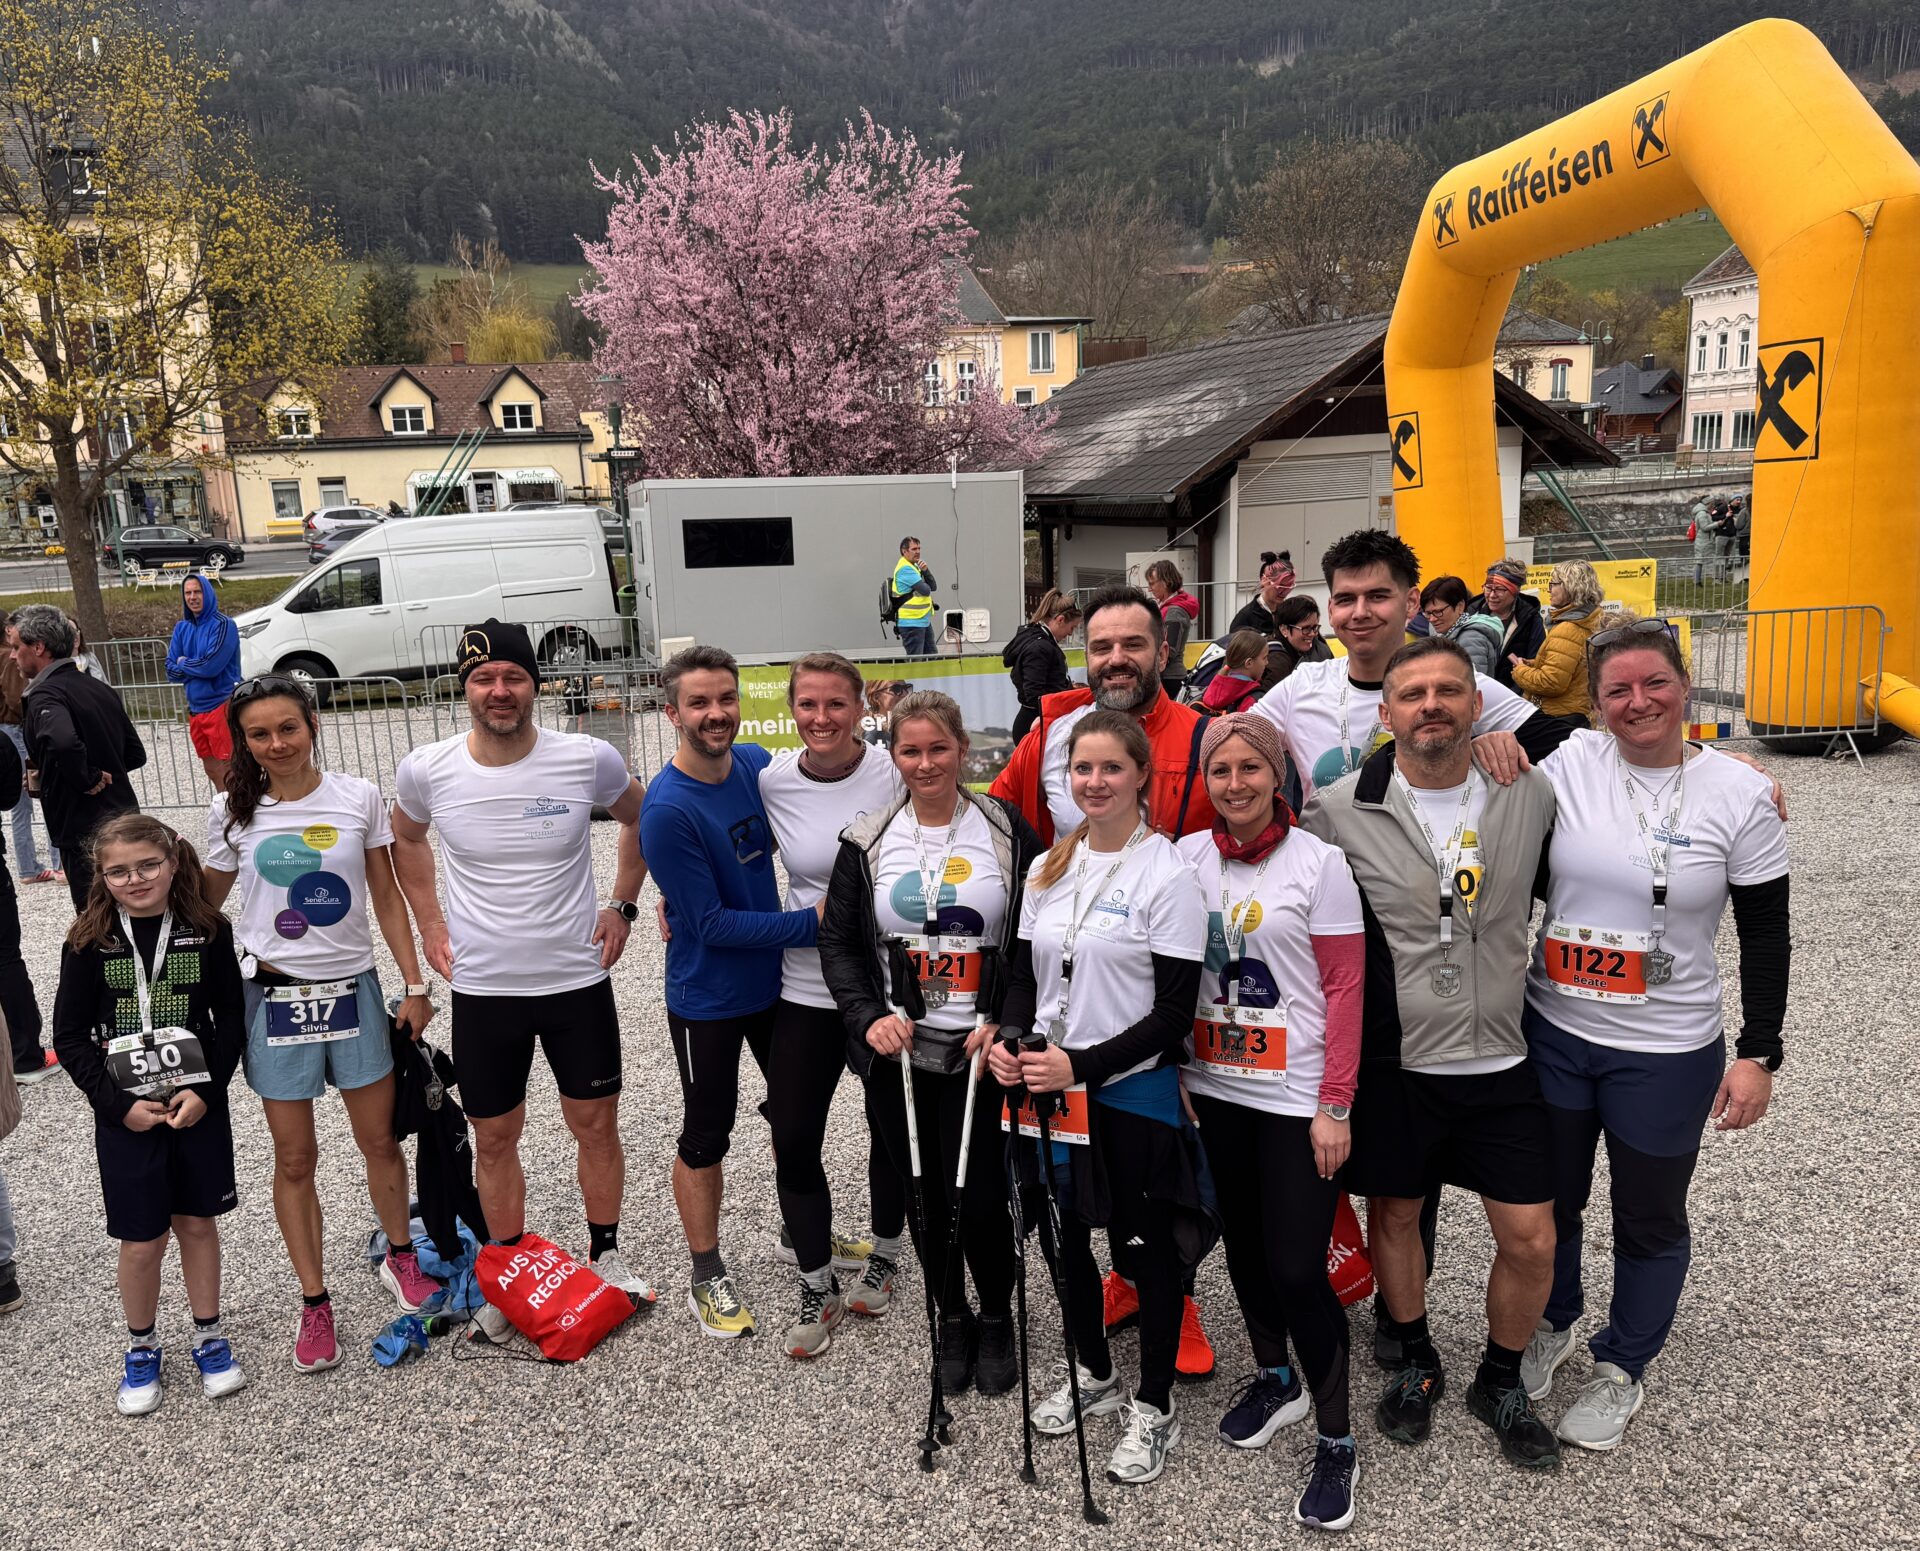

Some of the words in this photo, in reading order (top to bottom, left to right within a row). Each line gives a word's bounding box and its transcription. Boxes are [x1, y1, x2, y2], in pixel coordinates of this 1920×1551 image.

[1467, 139, 1614, 230] Raiffeisen
[516, 470, 545, 479] Gruber
[748, 681, 789, 690] BUCKLIG
[748, 690, 774, 699] WELT
[524, 804, 568, 813] SeneCura
[1560, 944, 1626, 979] 1122
[1573, 974, 1607, 988] Beate
[290, 999, 337, 1024] 317
[300, 1023, 330, 1034] Silvia
[129, 1043, 182, 1076] 50
[1213, 1051, 1258, 1066] Melanie
[138, 1068, 185, 1084] Vanessa
[497, 1253, 530, 1292] AUS
[526, 1250, 562, 1281] ZUR
[527, 1260, 586, 1310] REGION
